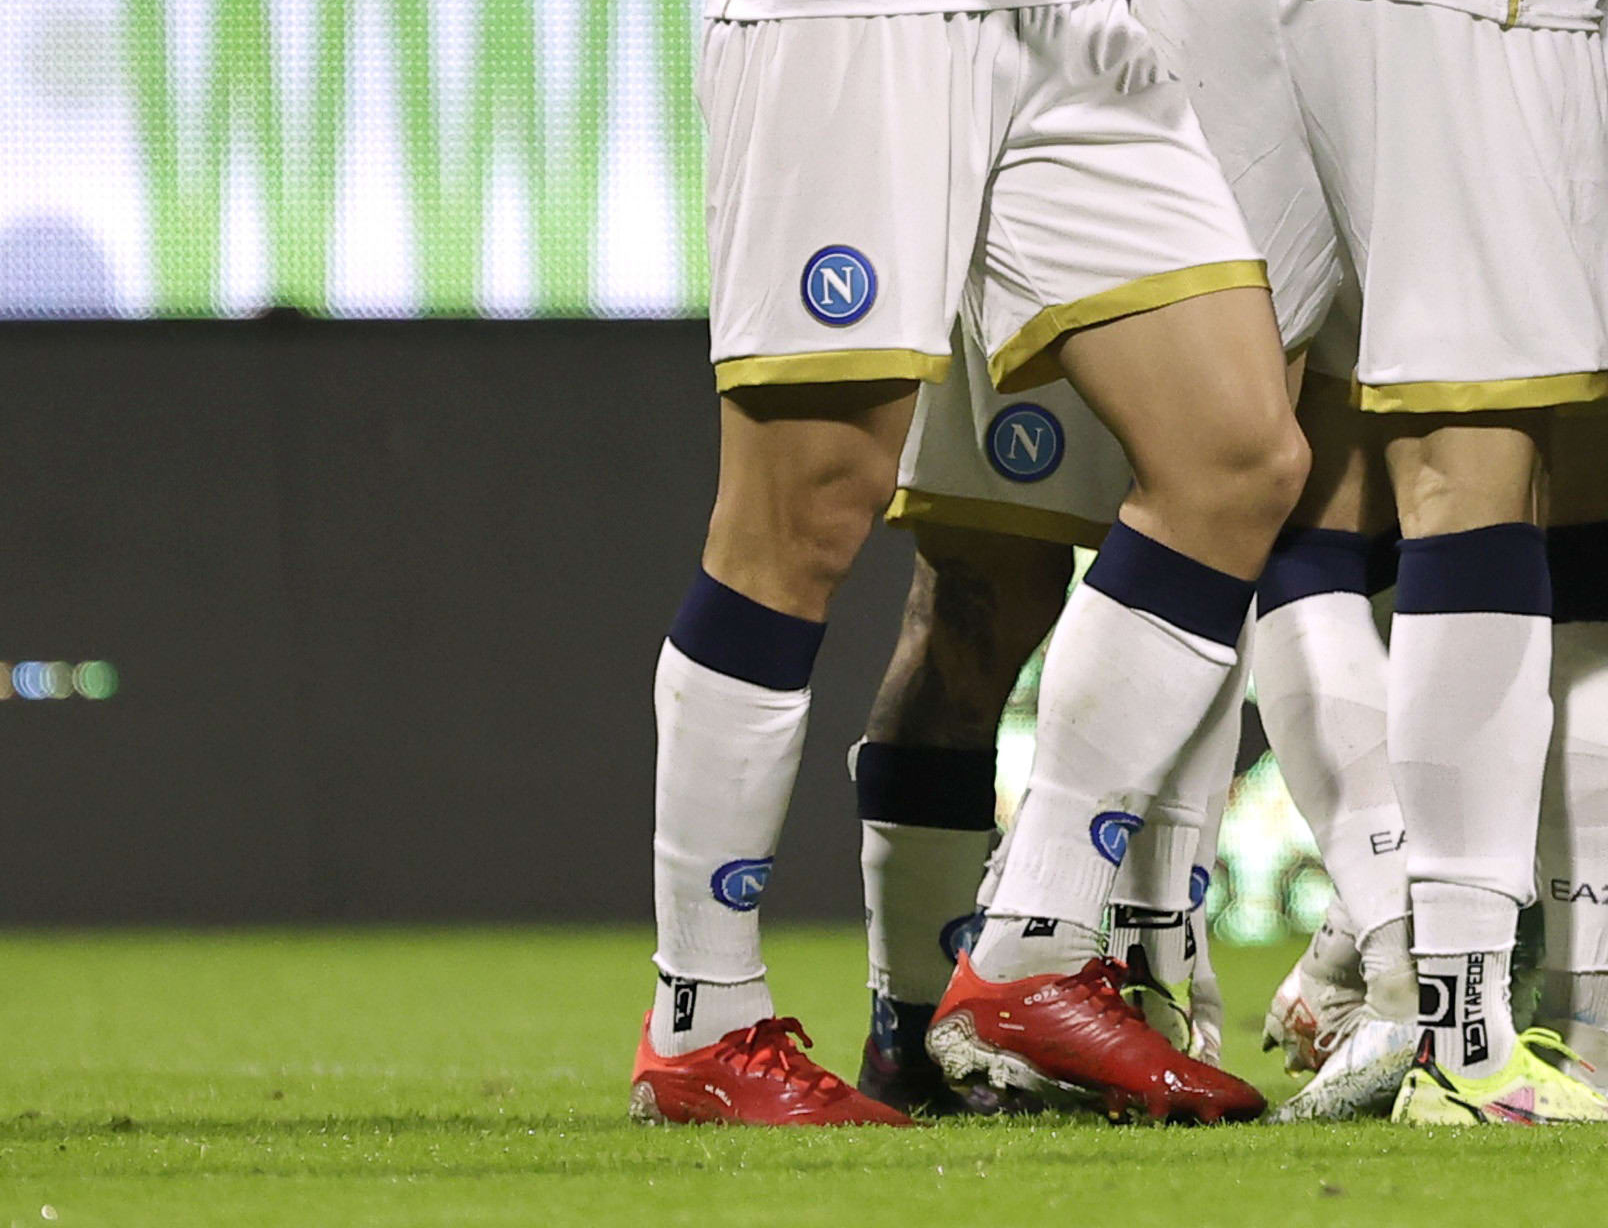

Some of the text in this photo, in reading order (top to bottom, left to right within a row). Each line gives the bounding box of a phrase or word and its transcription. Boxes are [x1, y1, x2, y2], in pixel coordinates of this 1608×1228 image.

[819, 266, 854, 305] N
[1007, 423, 1044, 463] N
[1024, 987, 1060, 1006] COPA
